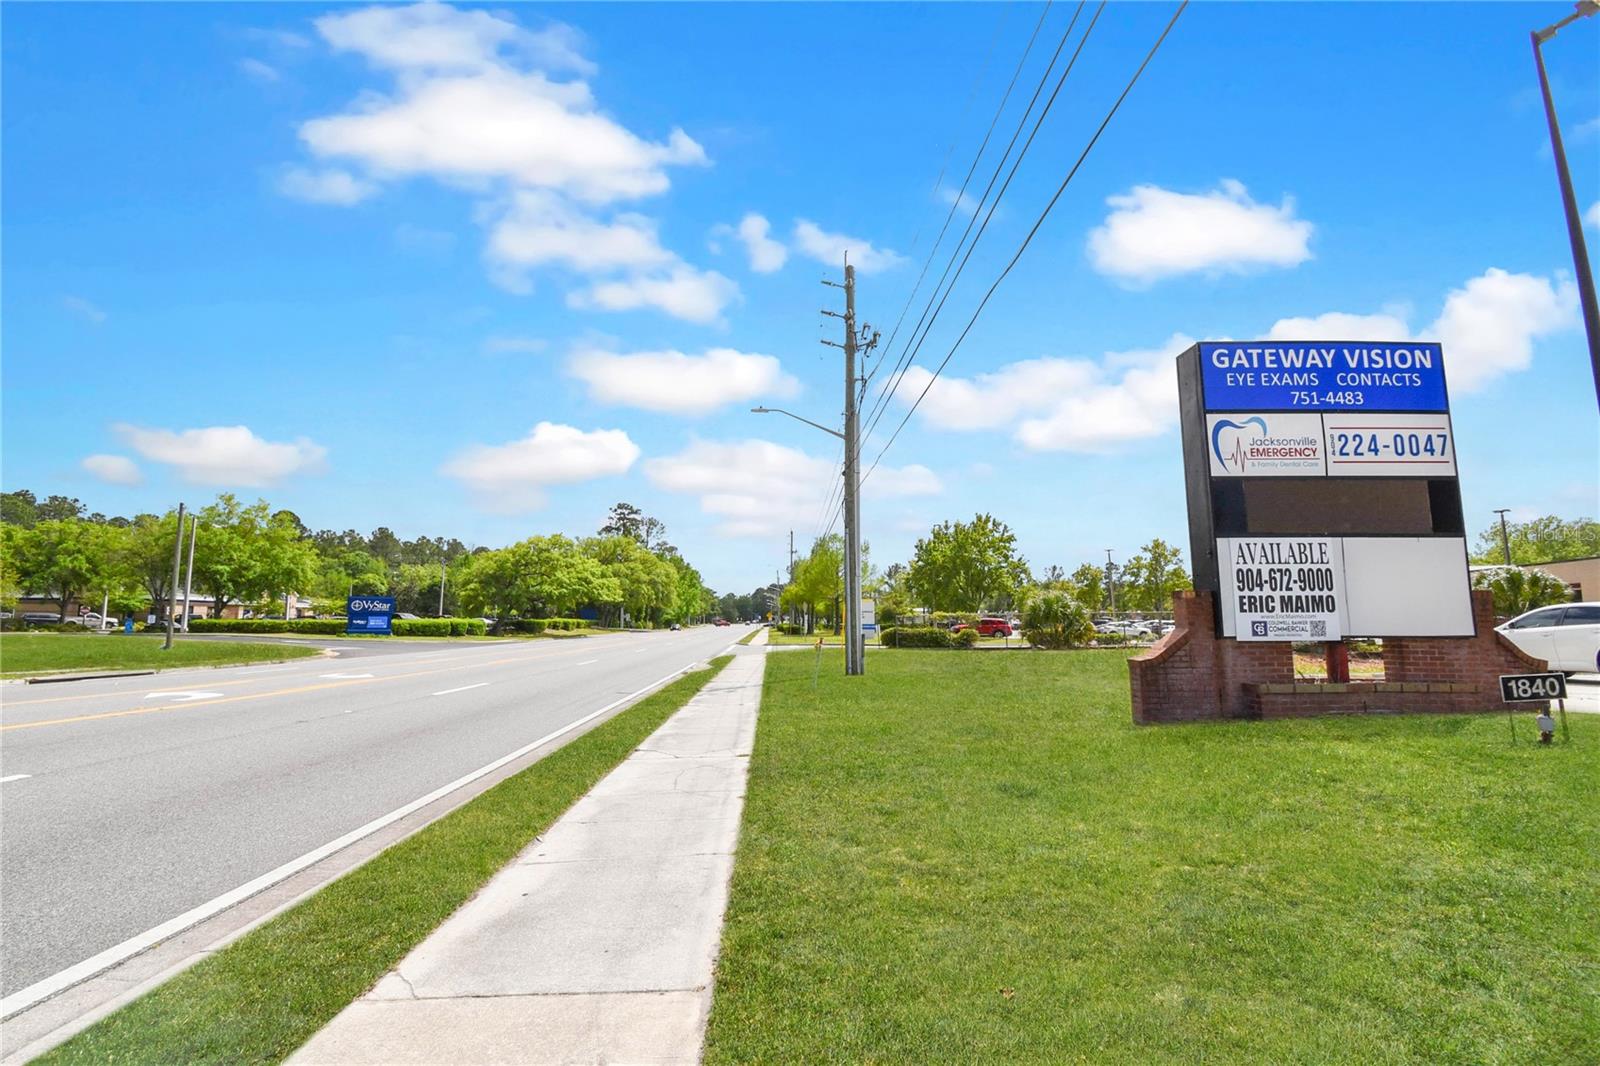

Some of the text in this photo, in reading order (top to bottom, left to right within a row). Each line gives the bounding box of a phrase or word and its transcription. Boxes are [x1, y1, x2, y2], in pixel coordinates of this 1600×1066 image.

[1212, 349, 1433, 369] GATEWAY VISION
[1226, 373, 1422, 386] EYE EXAMS CONTACTS
[1290, 391, 1364, 405] 751-4483
[1249, 437, 1317, 446] Jacksonville
[1338, 434, 1448, 456] 224-0047
[1250, 447, 1318, 457] EMERGENCY
[1236, 542, 1330, 565] AVAILABLE
[1236, 568, 1334, 592] 904-672-9000
[363, 600, 391, 611] VyStar
[1238, 594, 1336, 614] ERIC MAIMO
[1507, 677, 1560, 698] 1840
